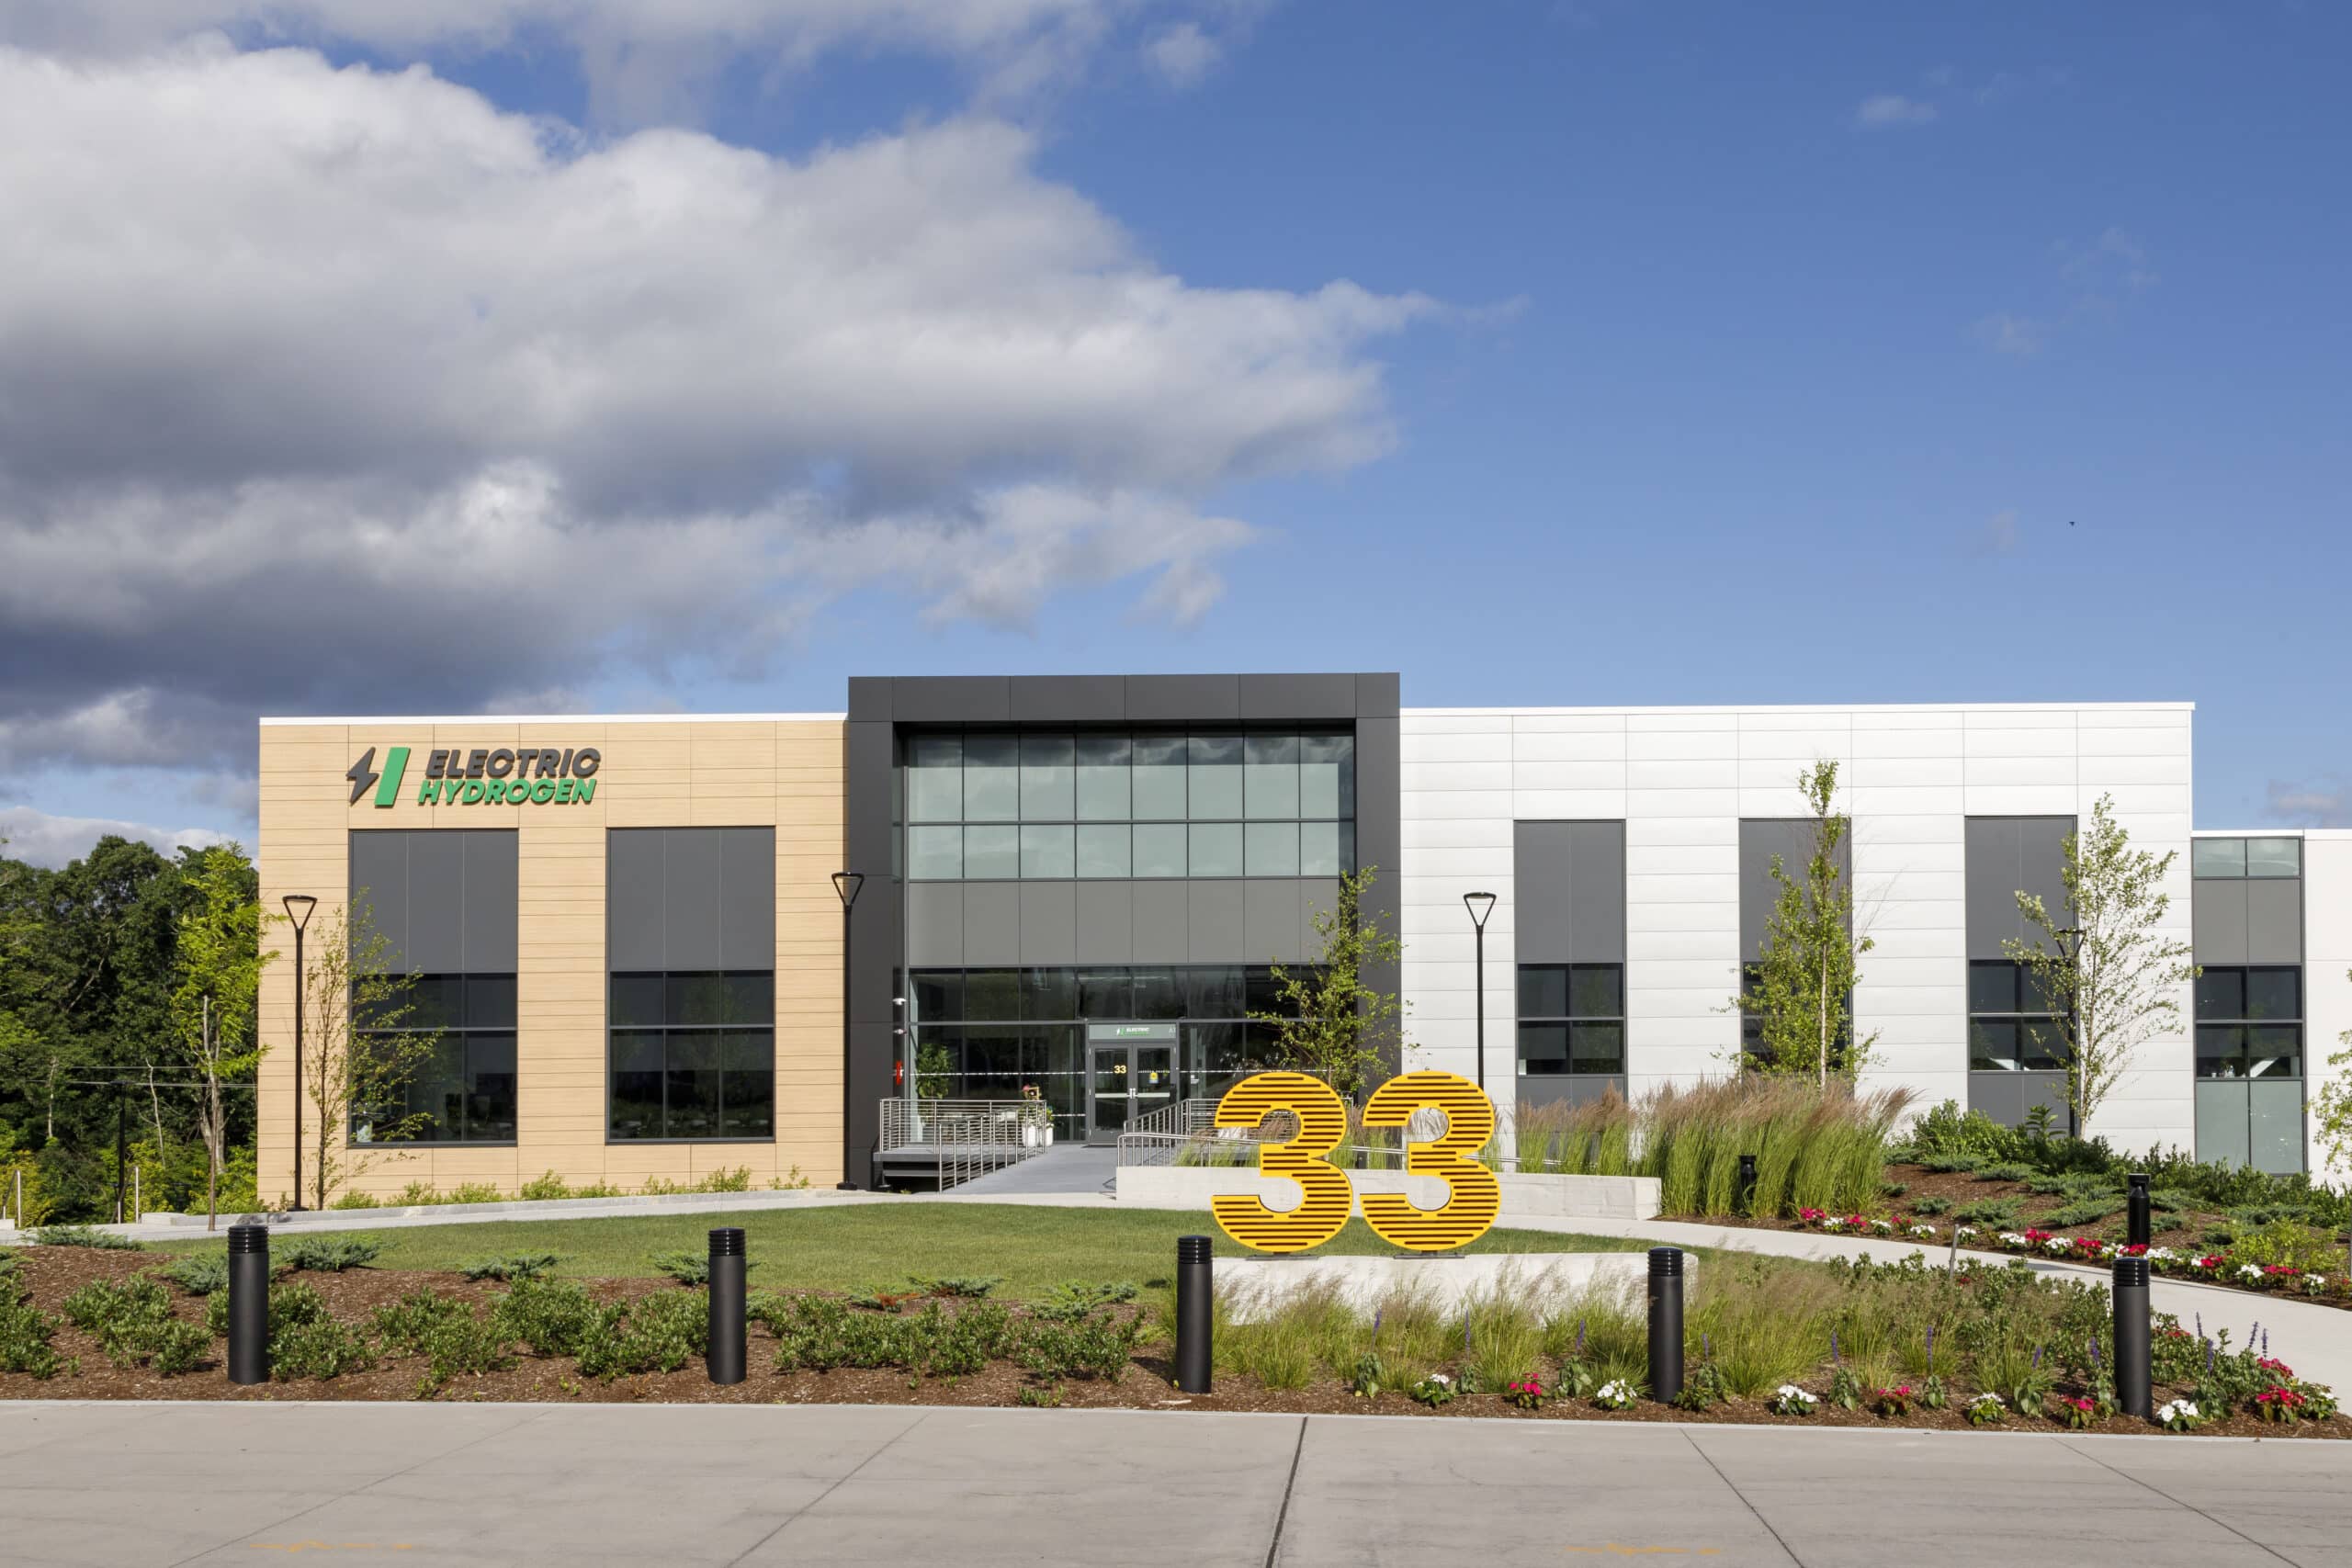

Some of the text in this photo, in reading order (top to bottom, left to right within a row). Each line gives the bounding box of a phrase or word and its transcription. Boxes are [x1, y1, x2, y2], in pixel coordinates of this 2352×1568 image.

[425, 748, 601, 778] ELECTRIC
[417, 778, 596, 805] HYDROGEN
[1114, 1065, 1126, 1074] 33
[1212, 1070, 1501, 1252] 33
